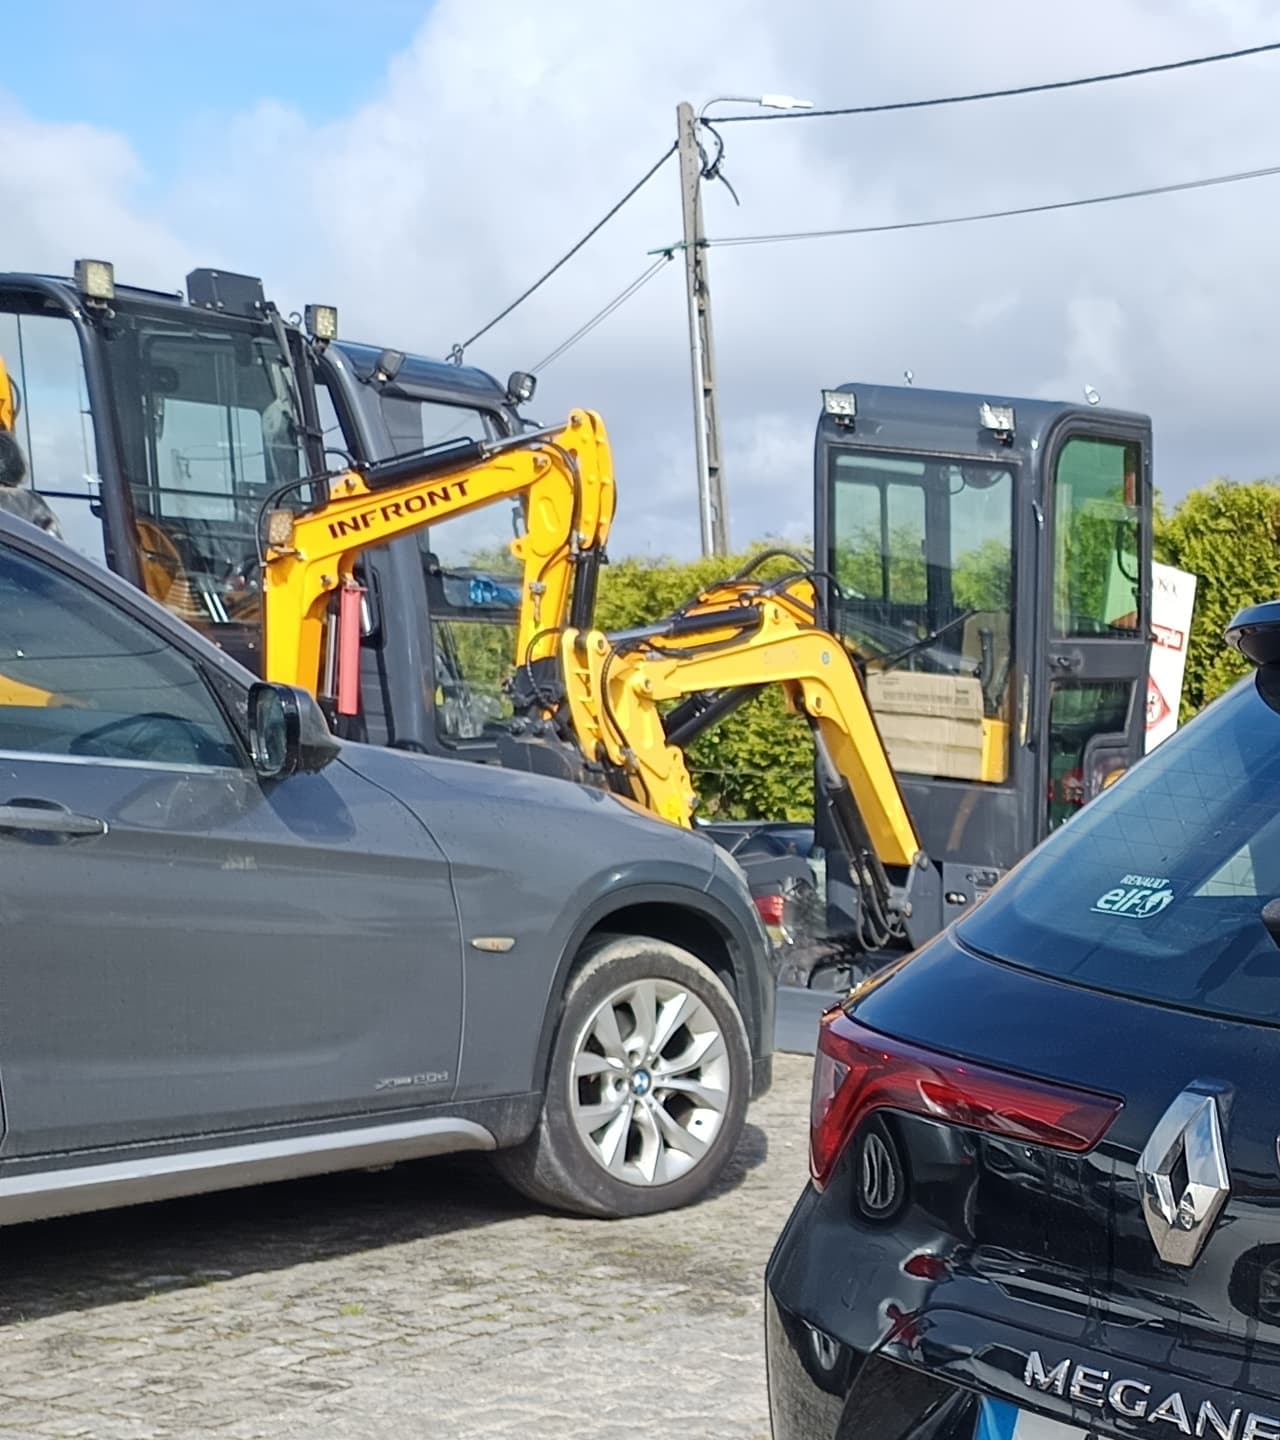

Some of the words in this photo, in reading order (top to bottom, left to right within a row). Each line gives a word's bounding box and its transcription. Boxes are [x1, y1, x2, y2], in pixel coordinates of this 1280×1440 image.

[328, 479, 469, 539] INFRONT
[1120, 874, 1170, 889] RENAULT
[1097, 888, 1153, 912] elf
